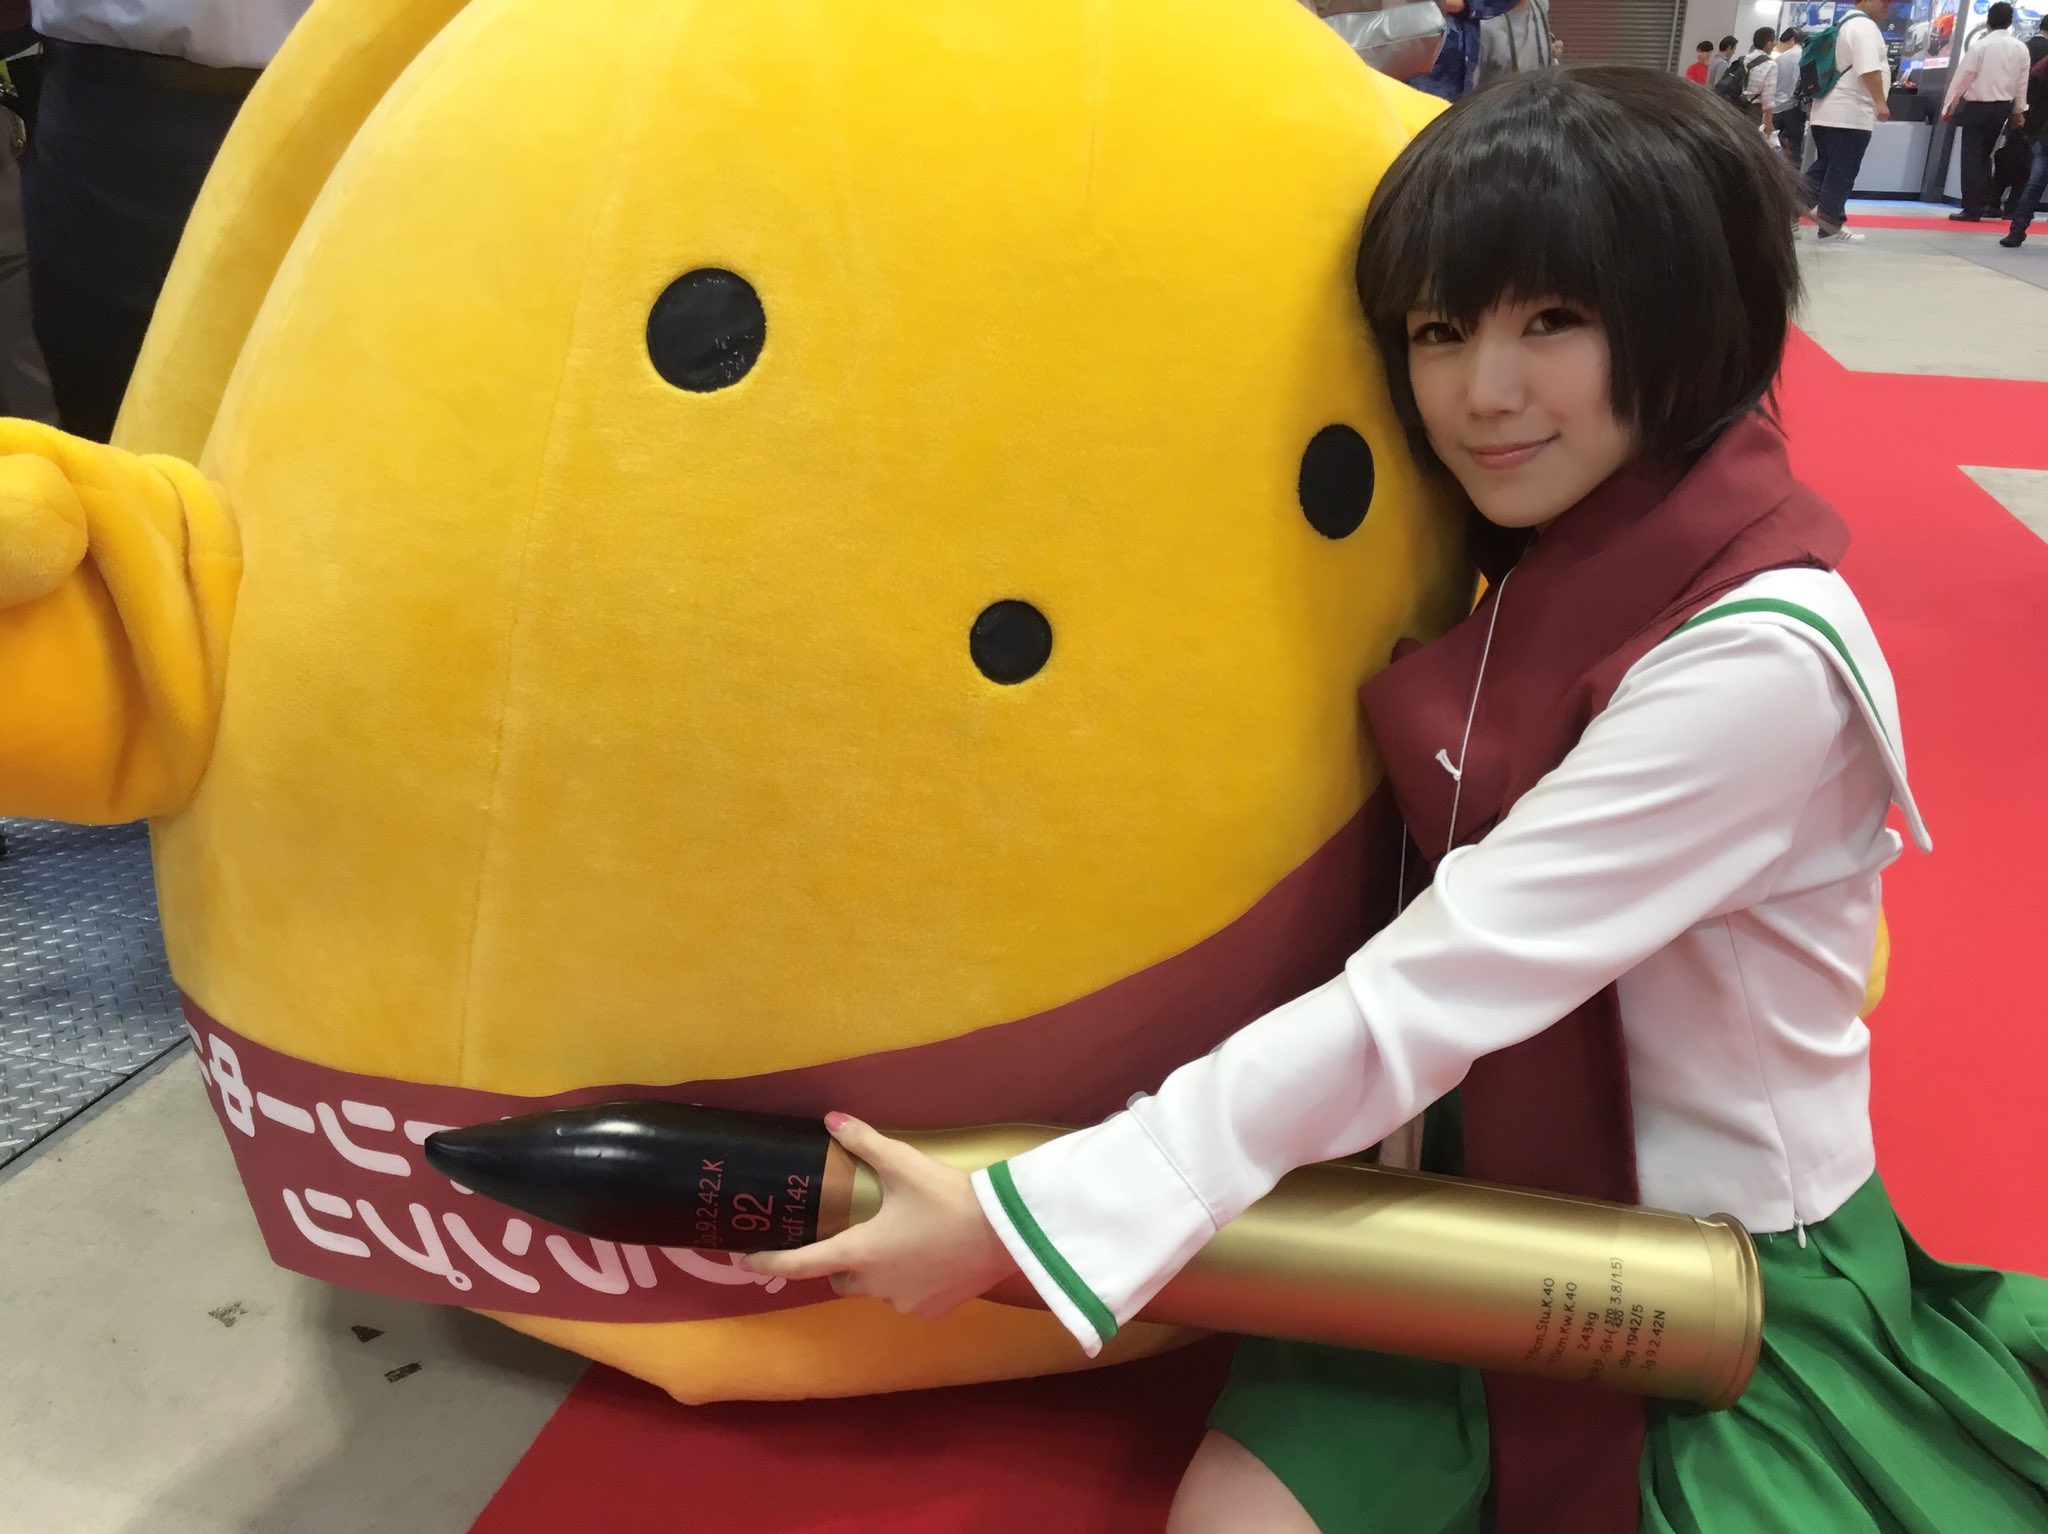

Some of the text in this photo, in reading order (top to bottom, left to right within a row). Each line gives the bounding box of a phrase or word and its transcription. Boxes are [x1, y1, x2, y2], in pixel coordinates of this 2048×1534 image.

[731, 1193, 774, 1232] 92
[1577, 1312, 1599, 1351] 2.43kg
[1626, 1304, 1644, 1347] 1942/5
